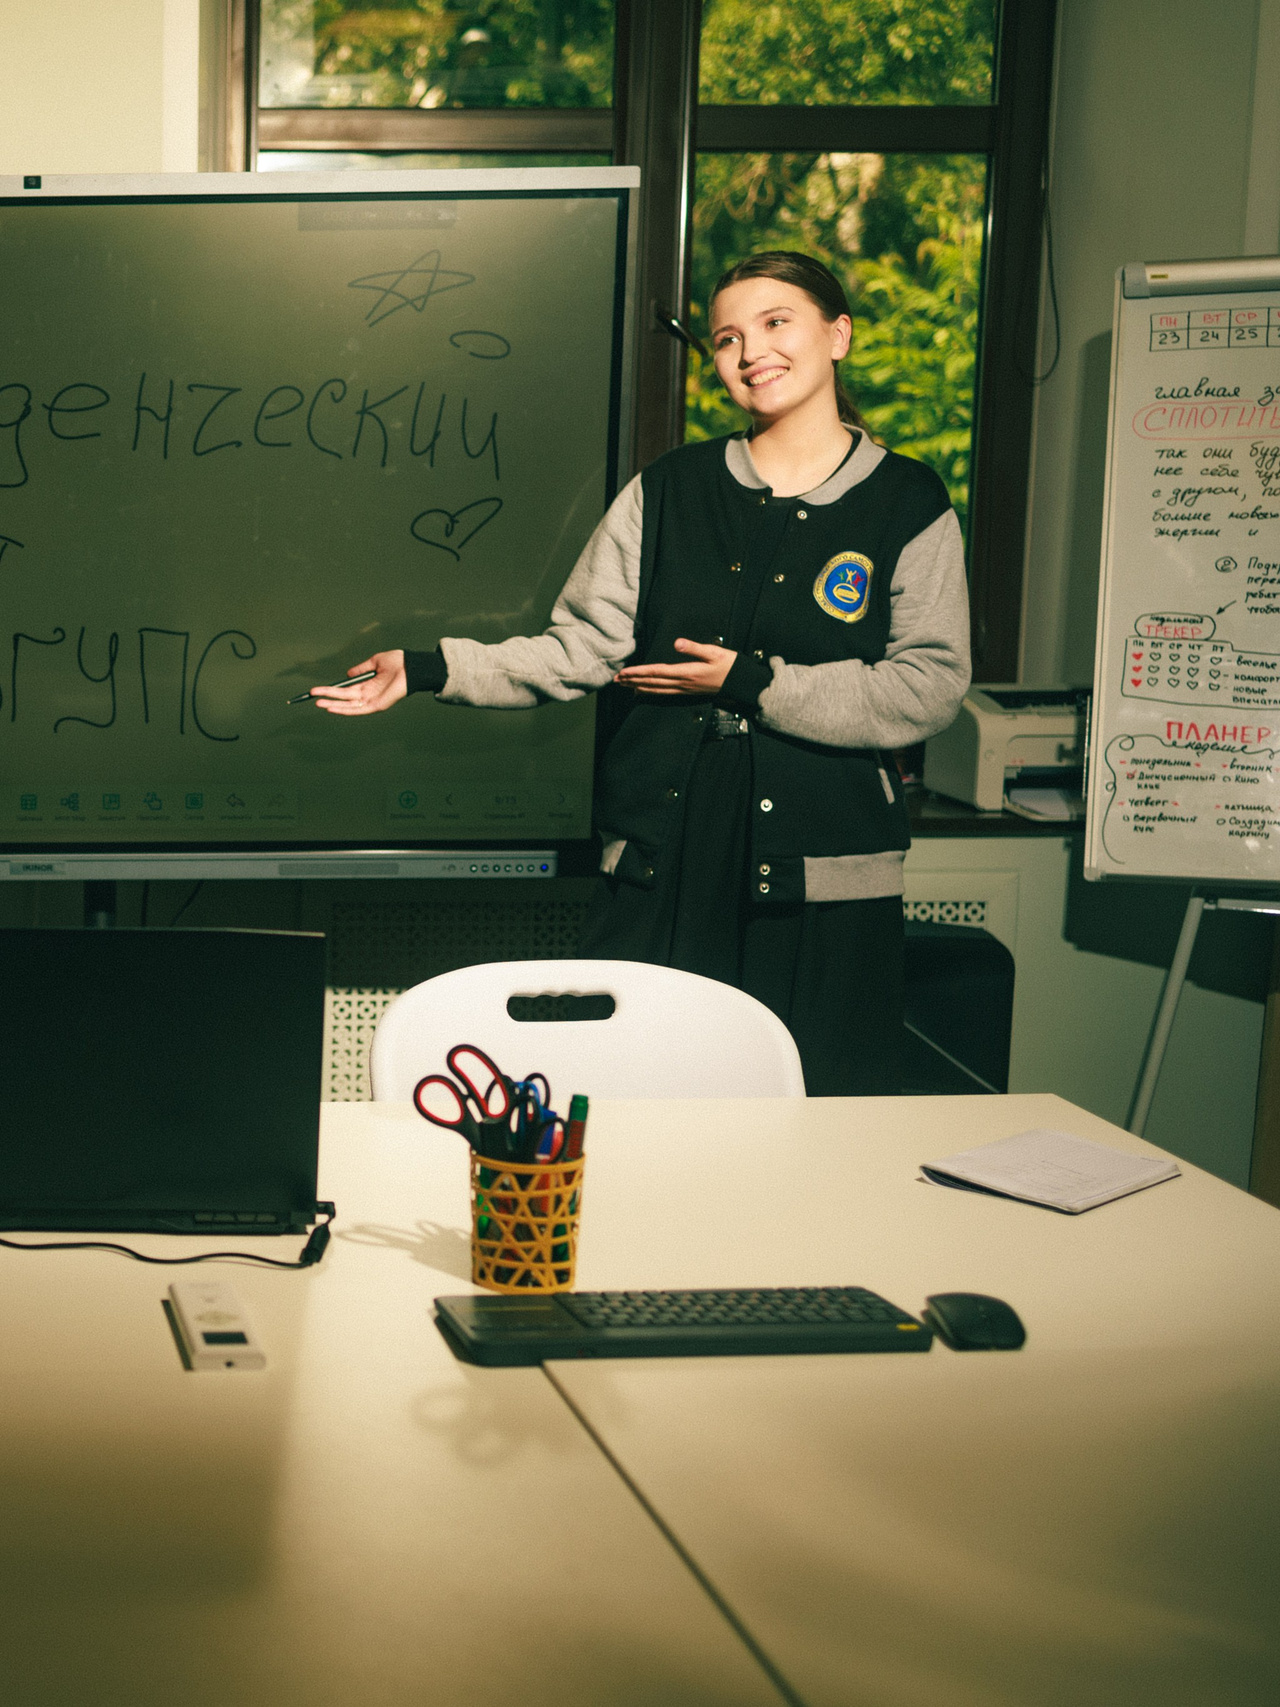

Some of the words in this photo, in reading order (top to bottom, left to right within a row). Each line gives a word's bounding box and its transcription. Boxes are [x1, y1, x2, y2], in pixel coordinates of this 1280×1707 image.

[1159, 316, 1178, 327] ПН
[1203, 312, 1228, 324] ВТ
[1235, 312, 1258, 325] СР
[1158, 331, 1180, 345] 23
[1200, 330, 1220, 342] 24
[1235, 328, 1259, 340] 25
[1154, 376, 1241, 400] главная
[1154, 448, 1188, 459] так
[1202, 447, 1234, 459] они
[1153, 465, 1184, 477] нее
[1200, 463, 1240, 478] себе
[1151, 507, 1212, 521] больше
[1247, 528, 1259, 537] и
[1144, 624, 1203, 640] ТРЕКЕР
[1166, 721, 1272, 744] ПЛАНЕР
